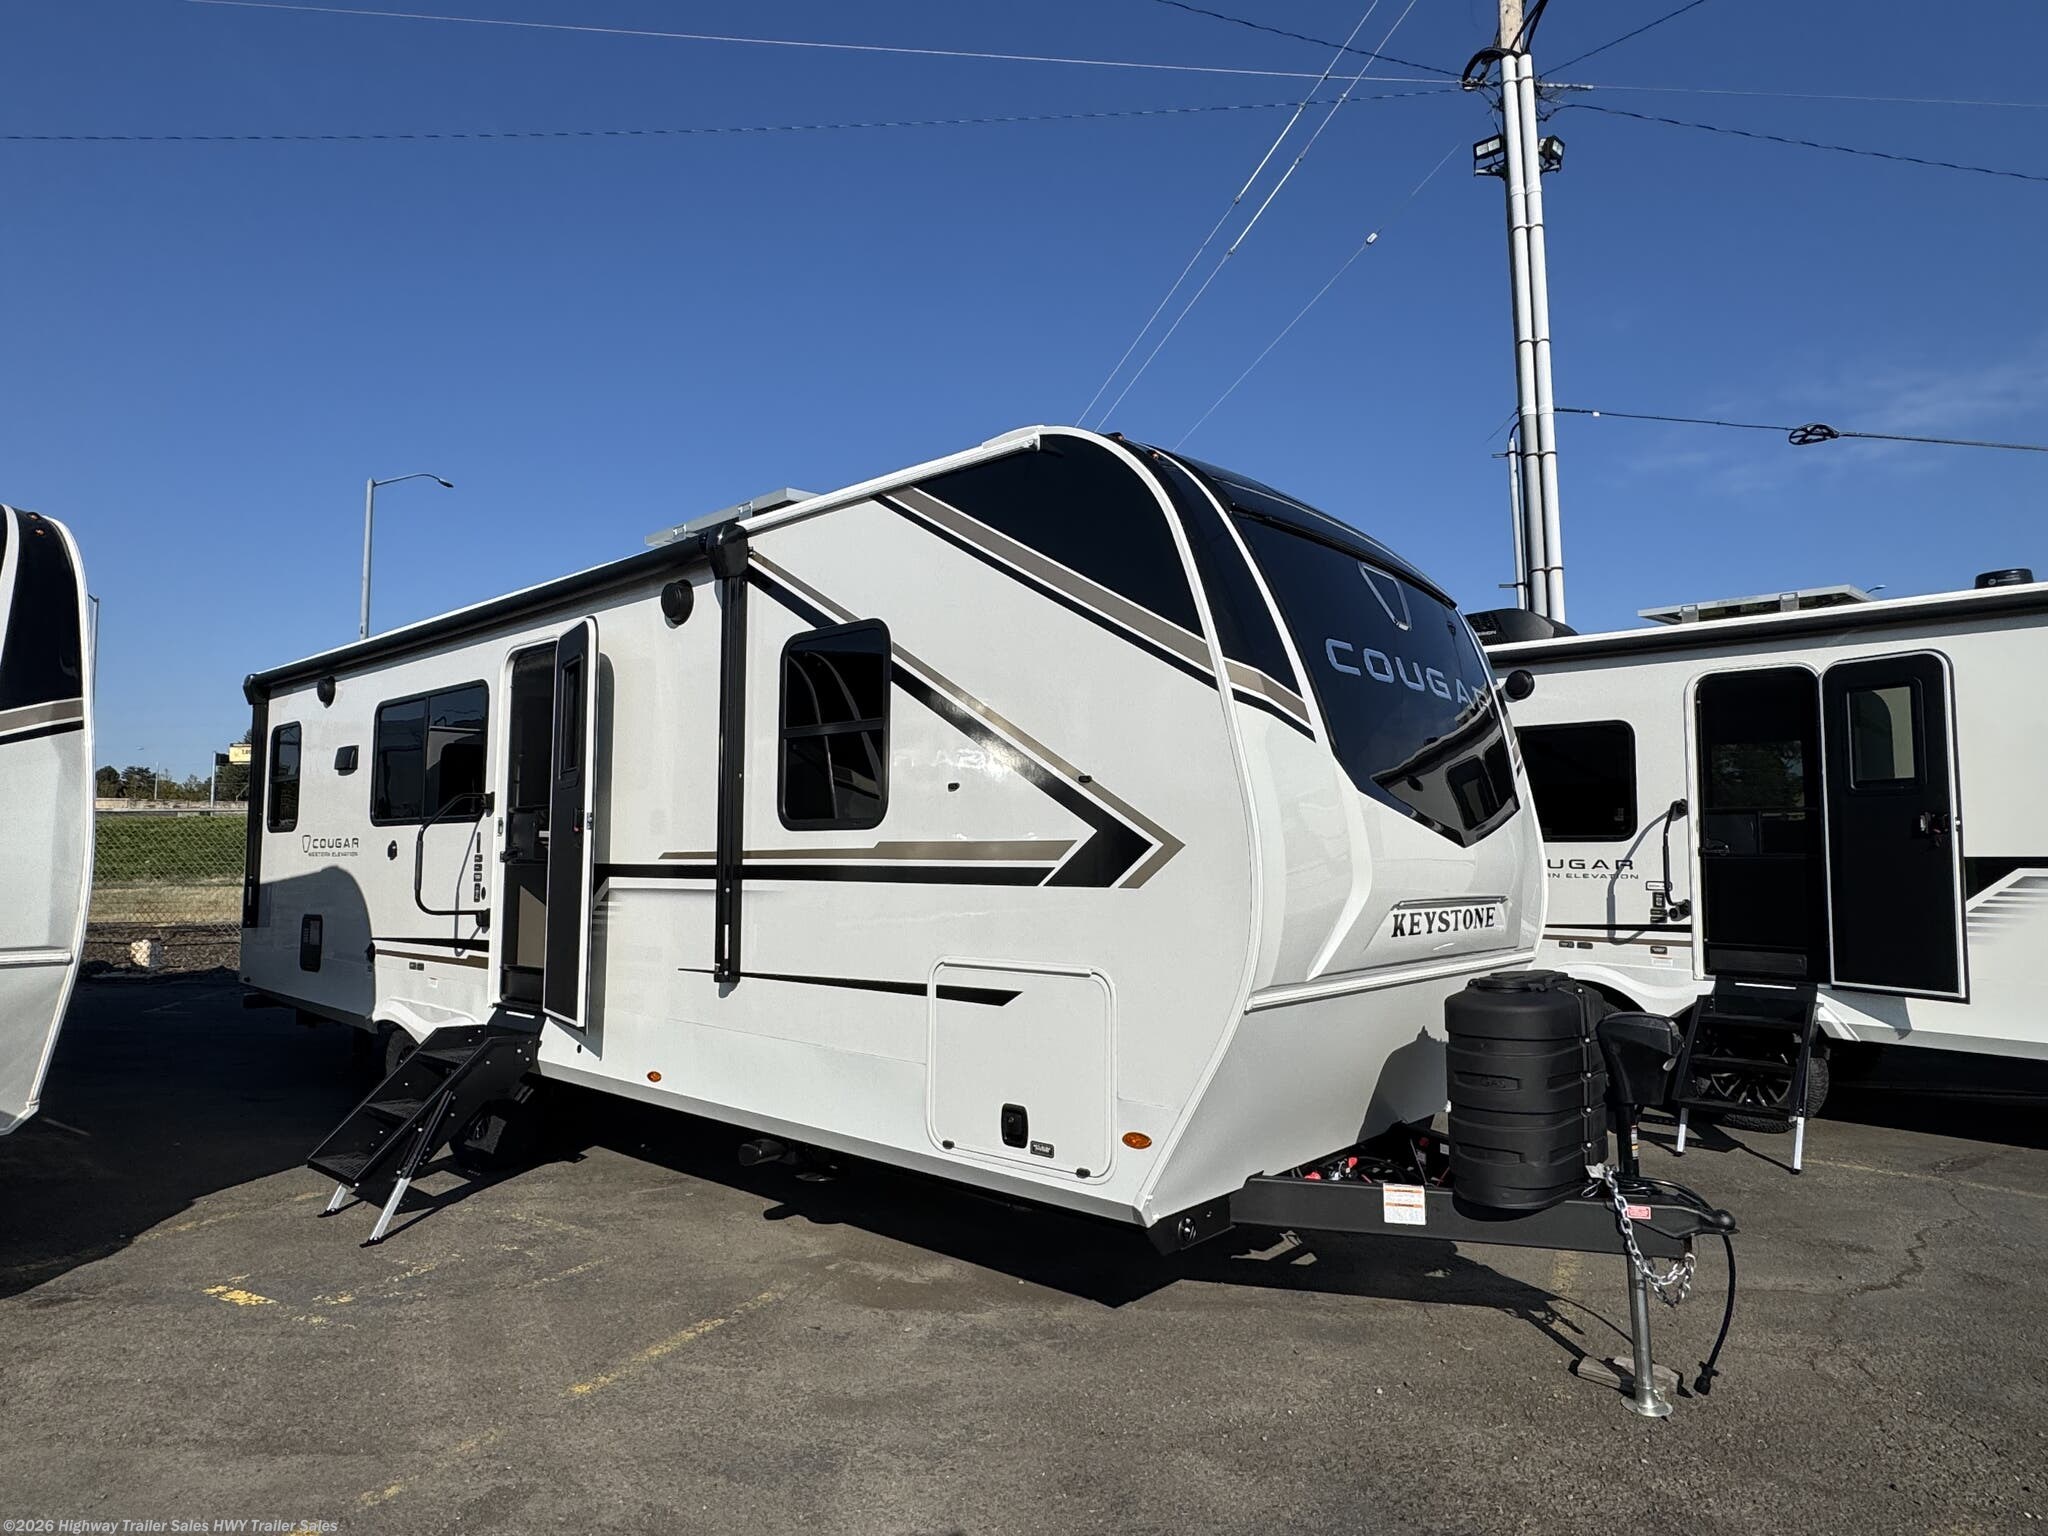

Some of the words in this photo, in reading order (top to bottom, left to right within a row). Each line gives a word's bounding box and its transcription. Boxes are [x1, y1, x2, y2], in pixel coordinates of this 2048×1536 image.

[1325, 638, 1495, 719] COUGAR
[312, 837, 359, 849] COUGAR
[1547, 858, 1634, 870] UGAR
[1391, 906, 1496, 938] KEYSTONE
